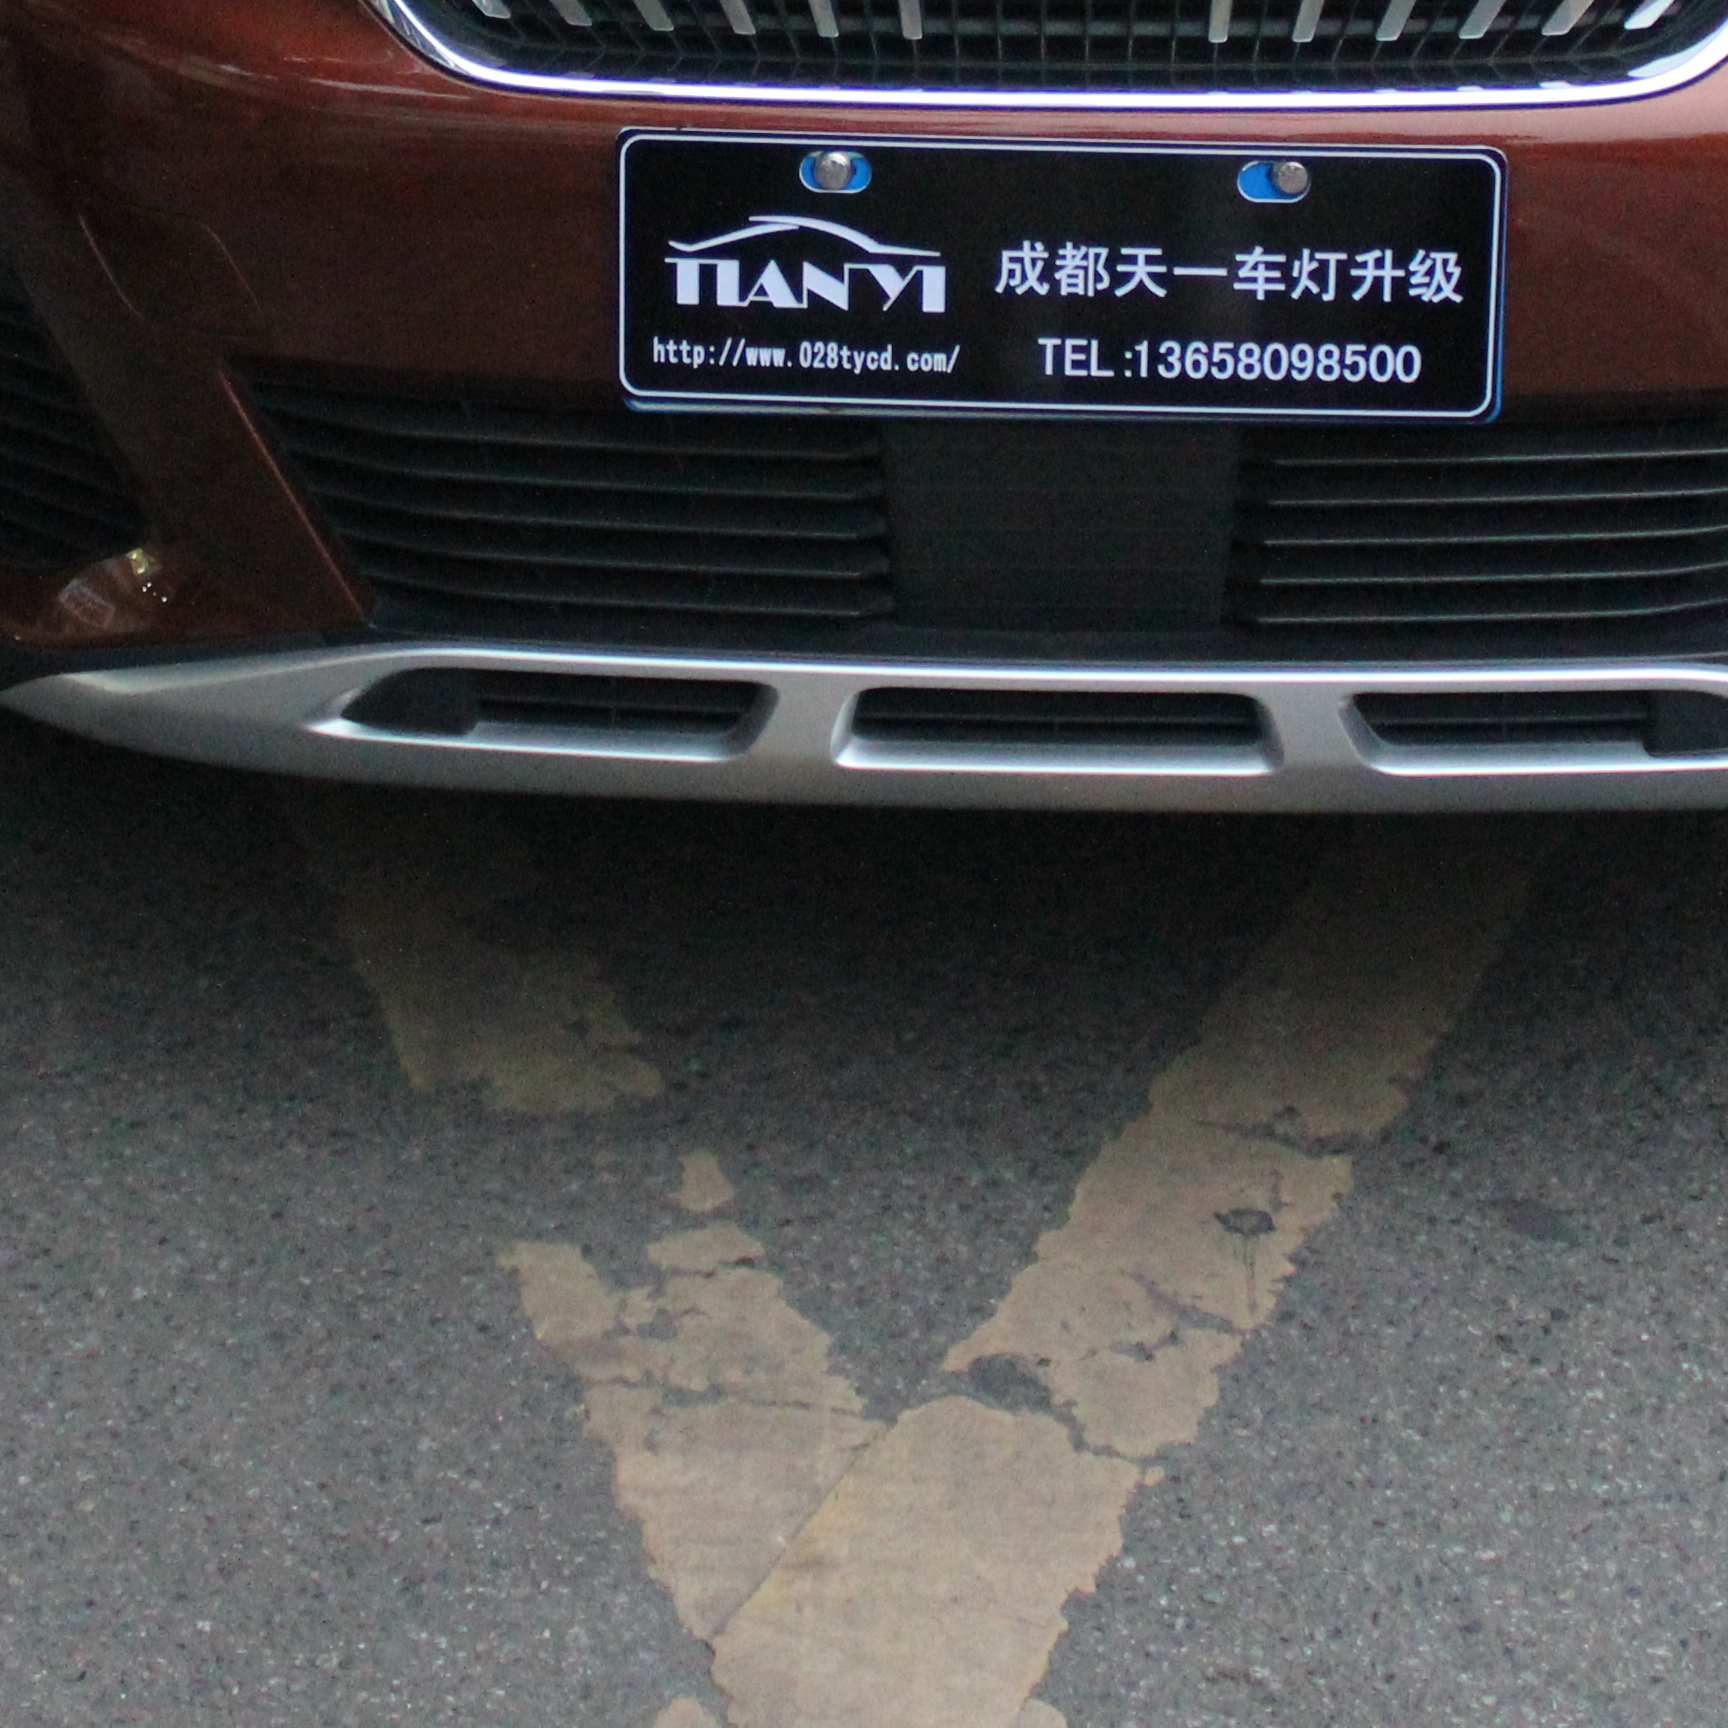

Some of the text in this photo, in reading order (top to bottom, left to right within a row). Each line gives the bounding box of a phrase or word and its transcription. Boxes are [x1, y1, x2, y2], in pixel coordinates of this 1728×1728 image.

[664, 257, 947, 314] TIANYI
[994, 239, 1464, 304] 成都天一车灯升级
[652, 335, 961, 374] http://www.028tycd.com/
